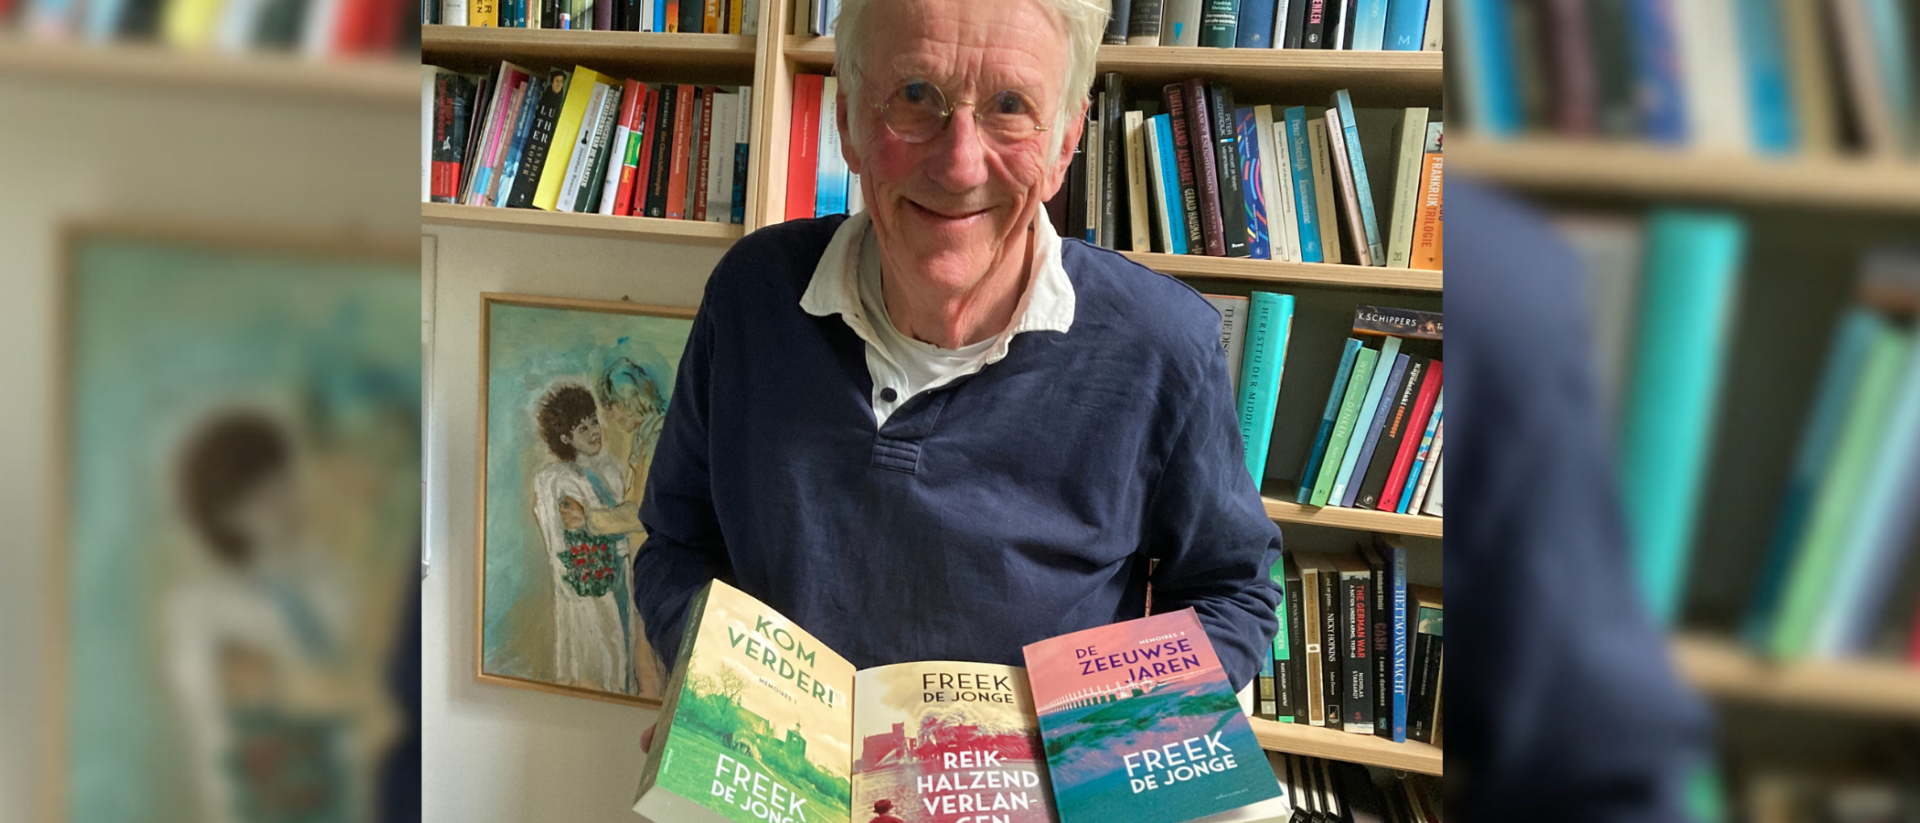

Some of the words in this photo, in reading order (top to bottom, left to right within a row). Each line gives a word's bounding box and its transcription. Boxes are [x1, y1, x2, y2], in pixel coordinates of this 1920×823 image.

[596, 88, 614, 135] GESCHIEDENIS
[608, 90, 620, 116] MICHEL
[1169, 89, 1184, 116] TURTLE
[1216, 95, 1226, 136] SLOTERDIJK
[599, 116, 613, 149] FOUCAULT
[1173, 119, 1188, 147] ISLAND
[1292, 119, 1302, 136] Peter
[1316, 124, 1324, 149] Friedrich
[589, 148, 598, 158] DE
[591, 135, 601, 149] VAN
[1197, 99, 1205, 123] DREAM
[1202, 135, 1213, 194] ENLIGHTENMENT
[1292, 137, 1306, 171] Sloterdijk
[523, 144, 536, 176] ROPER
[528, 146, 544, 184] LYNDAL
[573, 147, 585, 173] Jonathan
[581, 157, 595, 188] WAANZIN
[1177, 148, 1193, 186] ALPHABET
[1221, 146, 1230, 178] veranderen
[1318, 149, 1326, 175] Nietzsche
[1230, 175, 1238, 190] leven
[1184, 188, 1197, 210] GERALD
[1188, 211, 1201, 240] HAUSMAN
[1223, 306, 1234, 331] THE
[1366, 313, 1417, 327] SCHIPPERS
[1254, 307, 1269, 363] HERFSTTIJ
[1250, 367, 1260, 387] DER
[1355, 360, 1369, 382] WEG
[1336, 401, 1355, 438] DENKEN
[1331, 446, 1340, 459] Alan
[1325, 459, 1336, 477] Watts
[1356, 585, 1364, 601] THE
[1395, 591, 1404, 610] HET
[1327, 613, 1335, 633] NICKY
[1357, 603, 1365, 638] GERMAN
[1395, 611, 1404, 634] TAO
[756, 615, 816, 668] KOM
[1139, 632, 1178, 644] MEMOIRES
[1328, 634, 1336, 662] HOPKINS
[1357, 639, 1365, 658] WAR
[1375, 623, 1387, 650] CASH
[1395, 635, 1404, 655] VAN
[1075, 645, 1098, 659] DE
[1079, 638, 1193, 676] ZEEUWSE
[728, 626, 834, 708] VERDER!
[1125, 654, 1201, 684] JAREN
[1395, 658, 1404, 695] MACHT
[759, 678, 792, 702] MEMOIRES
[923, 673, 1012, 691] FREEK
[924, 692, 945, 703] DE
[951, 691, 1014, 703] JONGE
[944, 750, 1007, 769] REIK-
[1123, 731, 1231, 778] FREEK
[917, 770, 1039, 794] HALZEND
[1130, 776, 1158, 794] DE
[1164, 754, 1238, 786] JONGE
[711, 779, 736, 804] DE
[716, 753, 807, 822] FREEK
[923, 792, 1038, 815] VERLAN-
